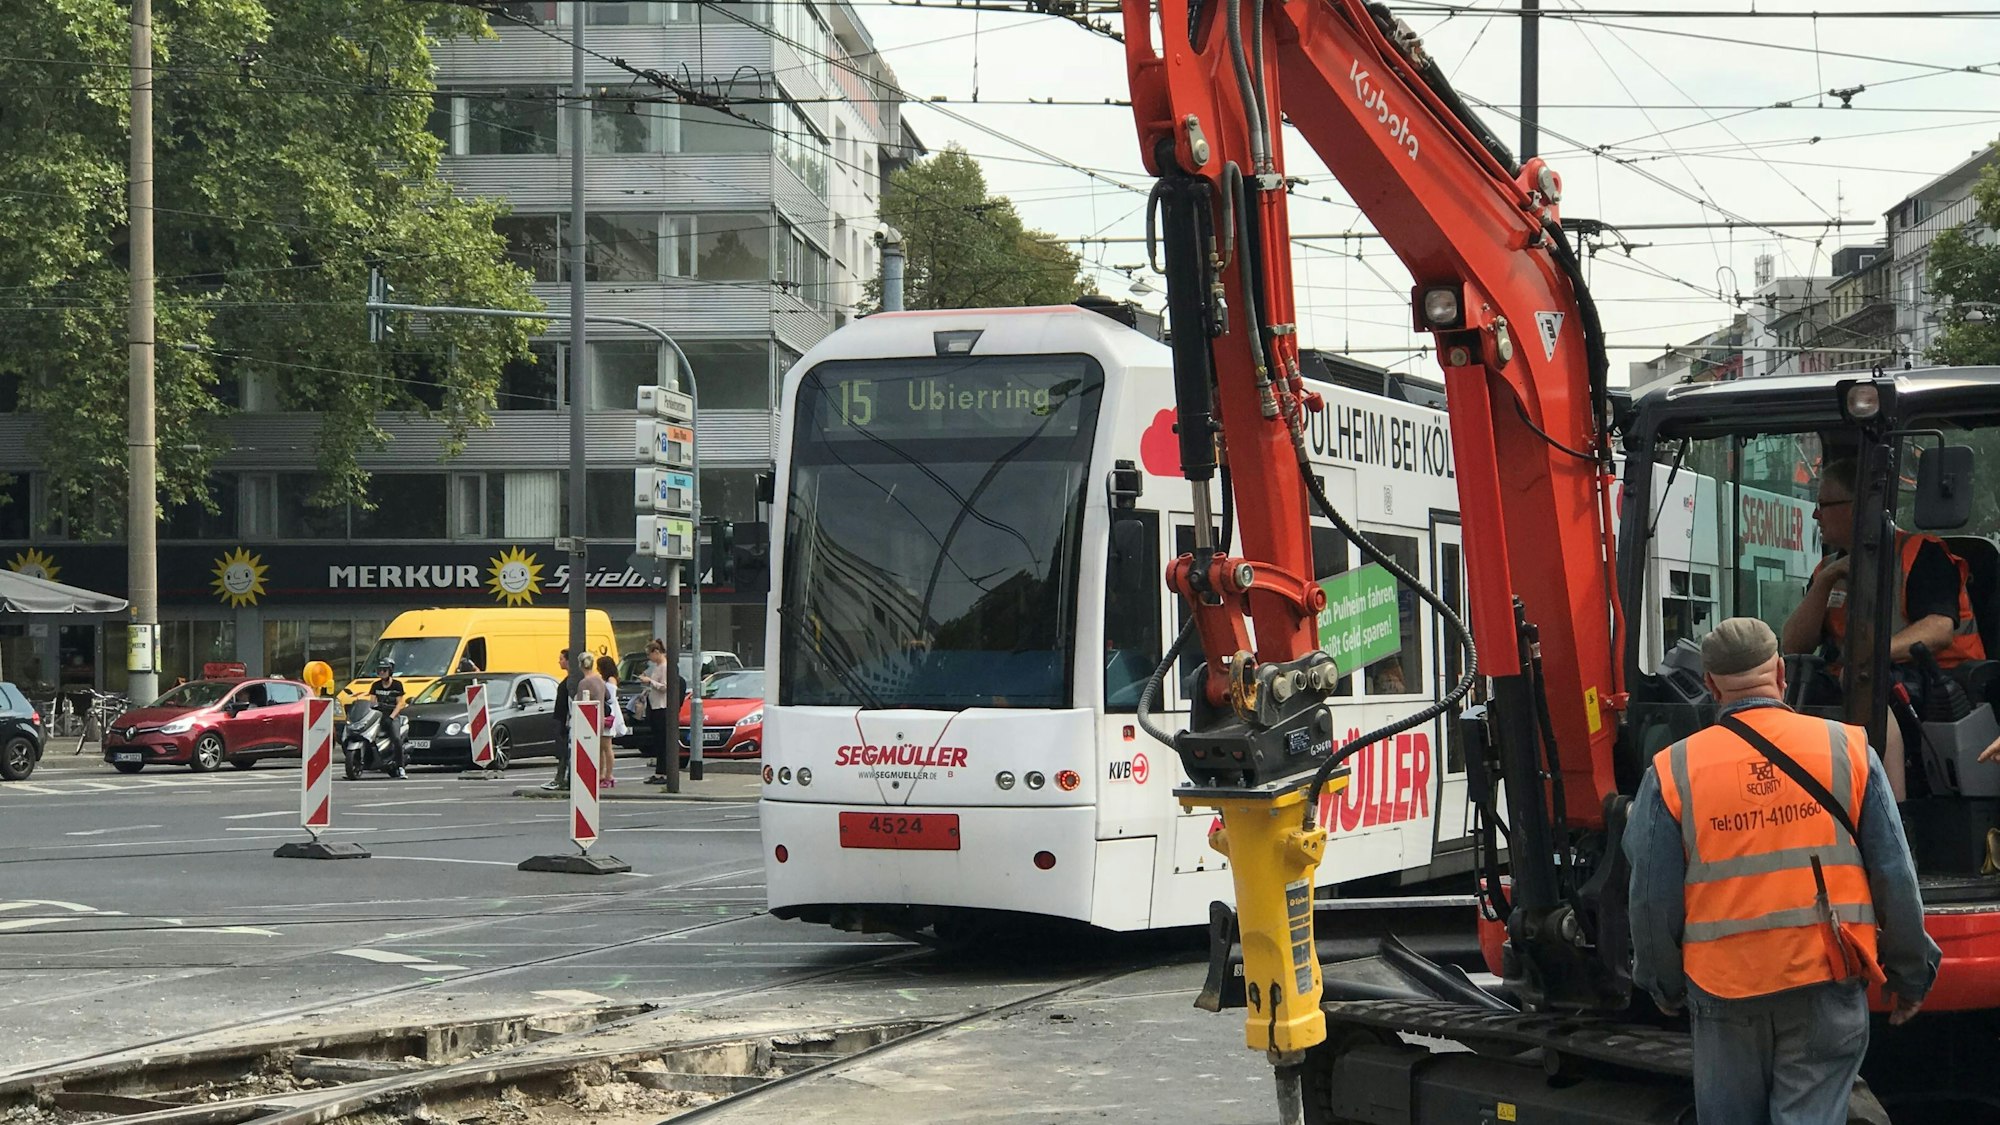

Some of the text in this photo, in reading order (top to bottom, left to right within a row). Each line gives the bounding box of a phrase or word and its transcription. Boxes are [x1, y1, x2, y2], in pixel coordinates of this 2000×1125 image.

[1350, 58, 1419, 161] Kubota
[839, 379, 1050, 426] 15 Ubierring
[1391, 416, 1418, 473] BEI
[1421, 415, 1455, 479] KÖL
[1743, 494, 1804, 552] SEGMÜLLER
[329, 565, 480, 588] MERKUR
[1317, 584, 1396, 629] ach Pulheim fahren,
[1342, 624, 1361, 653] Geld
[1363, 614, 1393, 649] sparen!
[835, 744, 968, 767] SEGMÜLLER
[1109, 761, 1131, 779] KVB
[1746, 778, 1782, 796] SECURITY
[869, 817, 923, 834] 4524
[1710, 815, 1732, 831] Tel:
